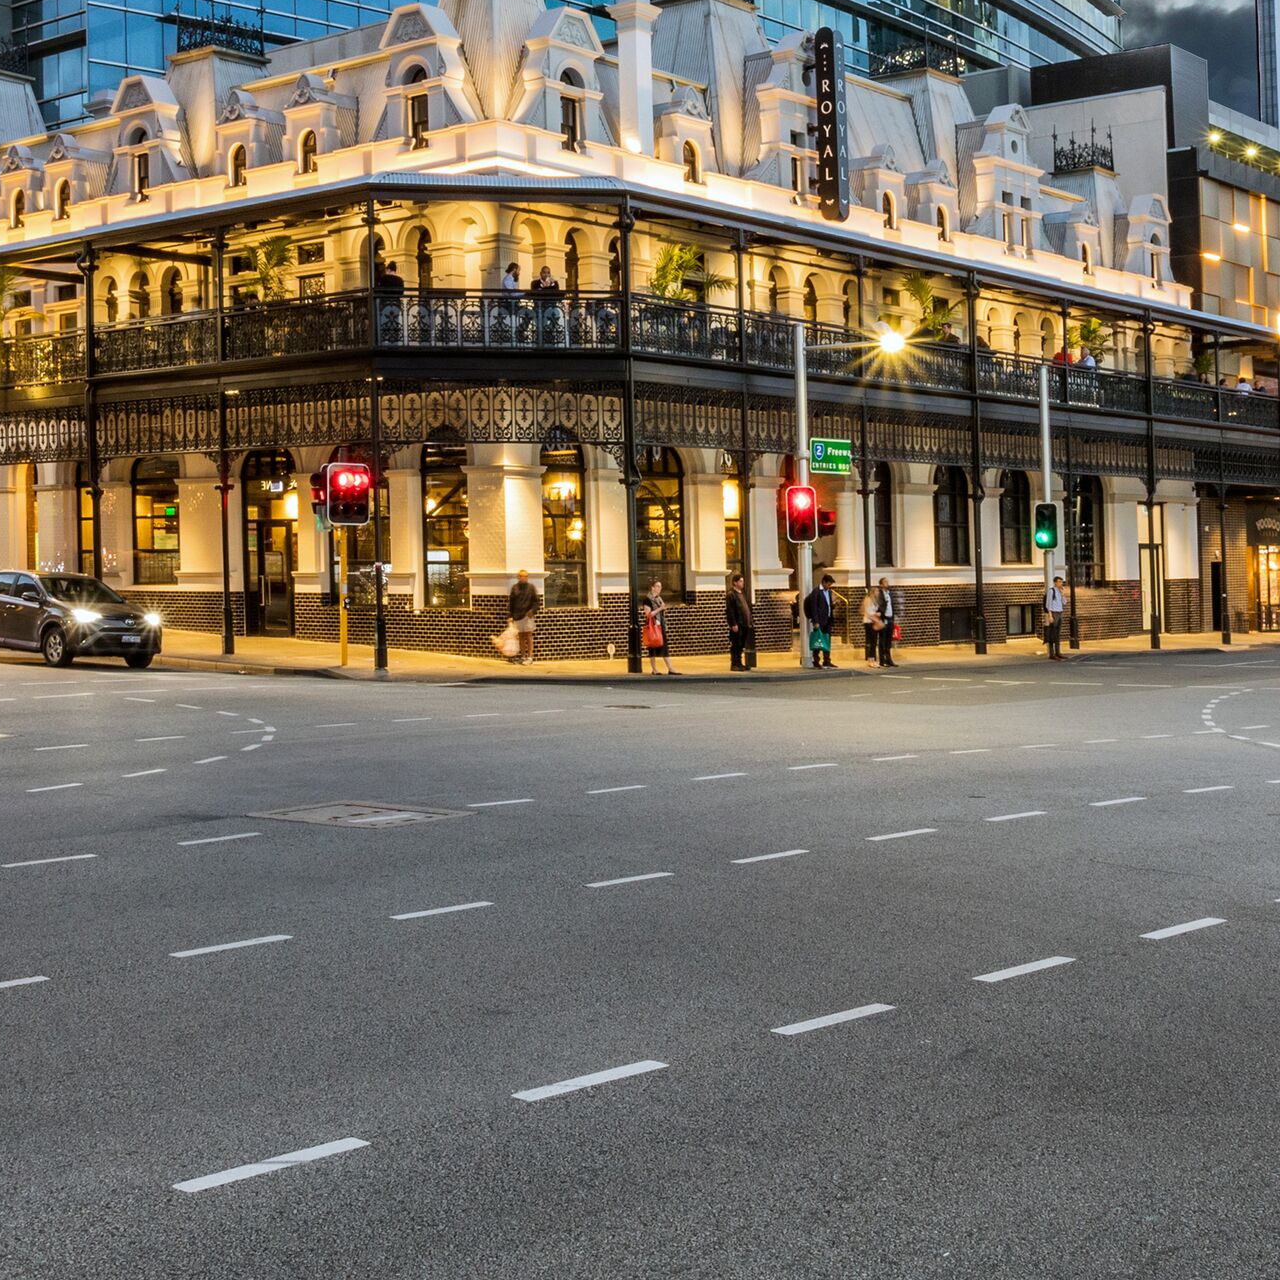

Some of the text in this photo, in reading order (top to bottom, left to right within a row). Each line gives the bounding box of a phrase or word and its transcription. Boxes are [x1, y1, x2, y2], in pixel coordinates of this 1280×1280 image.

[820, 79, 833, 181] ROYAL
[837, 78, 847, 181] ROYAL
[816, 445, 822, 456] 2
